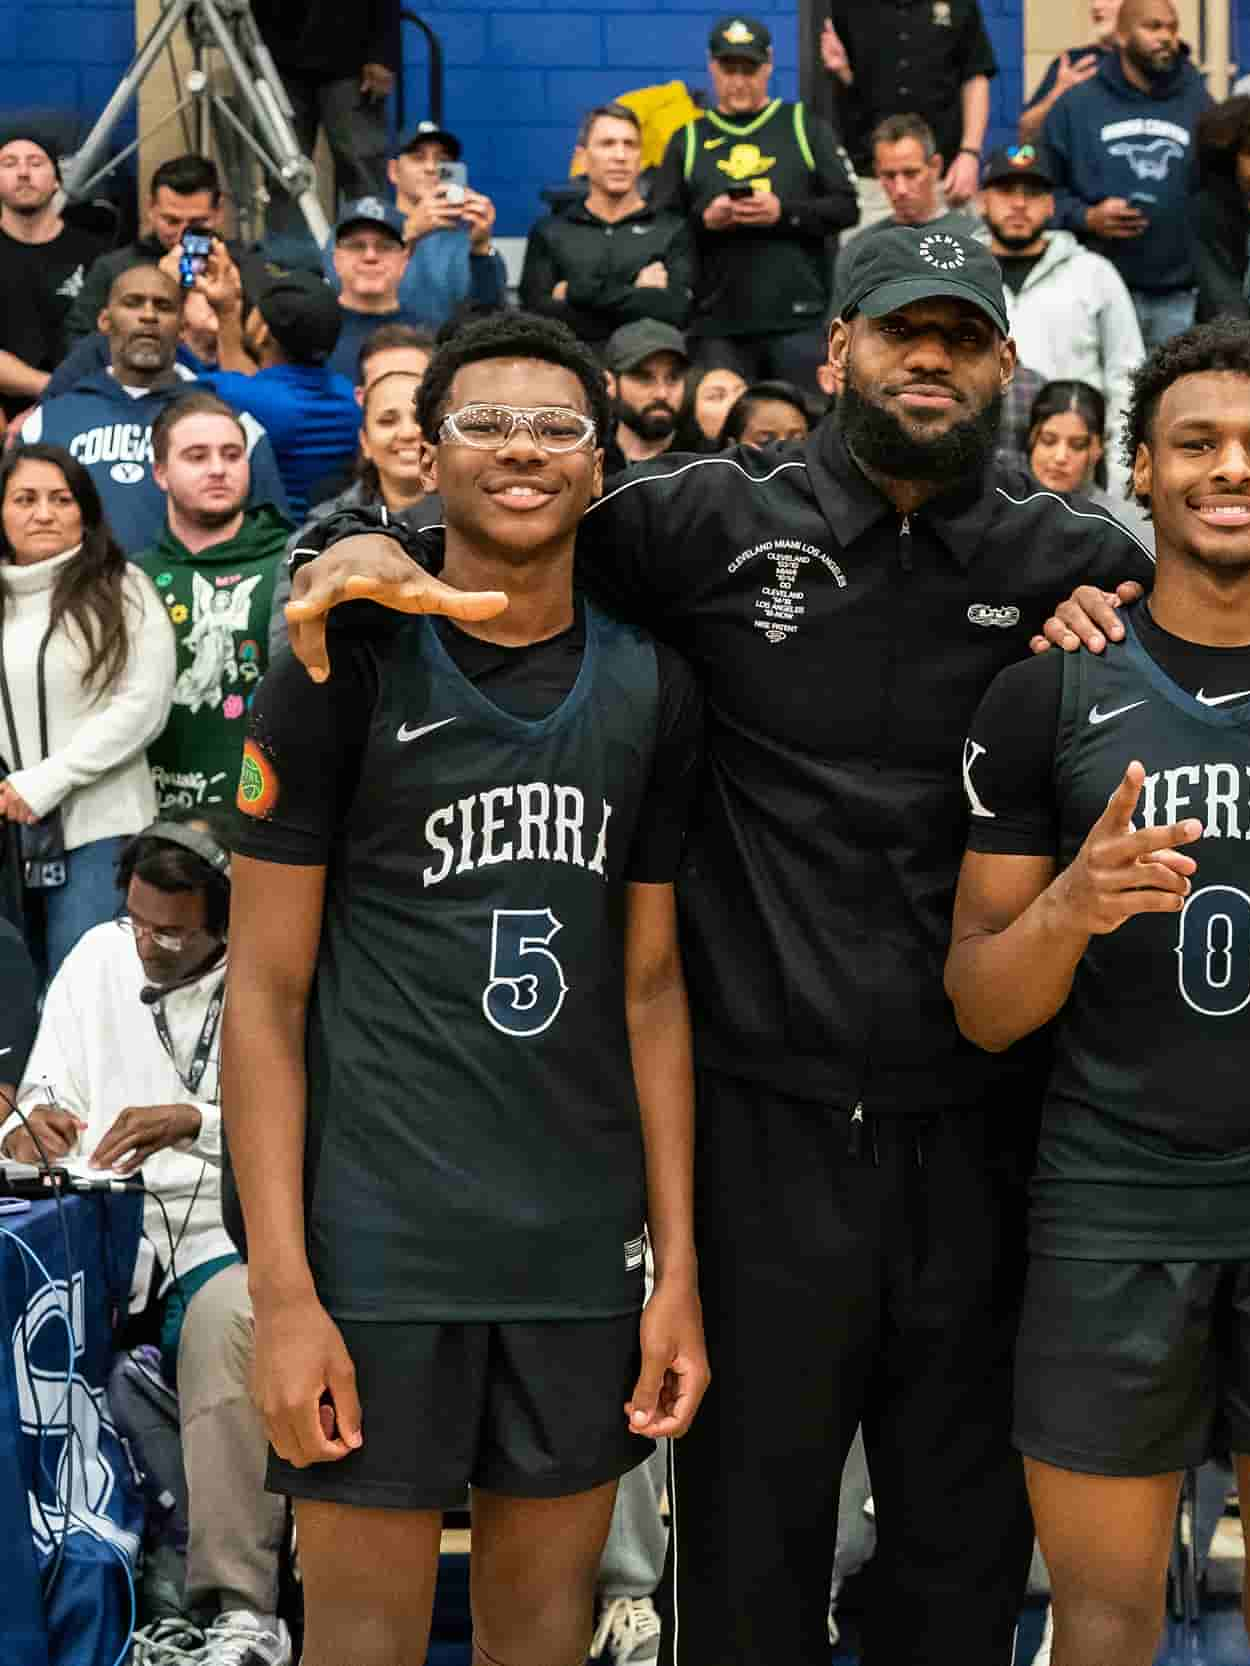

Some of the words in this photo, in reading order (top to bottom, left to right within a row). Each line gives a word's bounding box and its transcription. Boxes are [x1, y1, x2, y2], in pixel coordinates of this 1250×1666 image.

[727, 541, 773, 573] CLEVELAND
[773, 539, 802, 550] MIAMI
[801, 543, 821, 558] LOS
[482, 907, 570, 1037] 5
